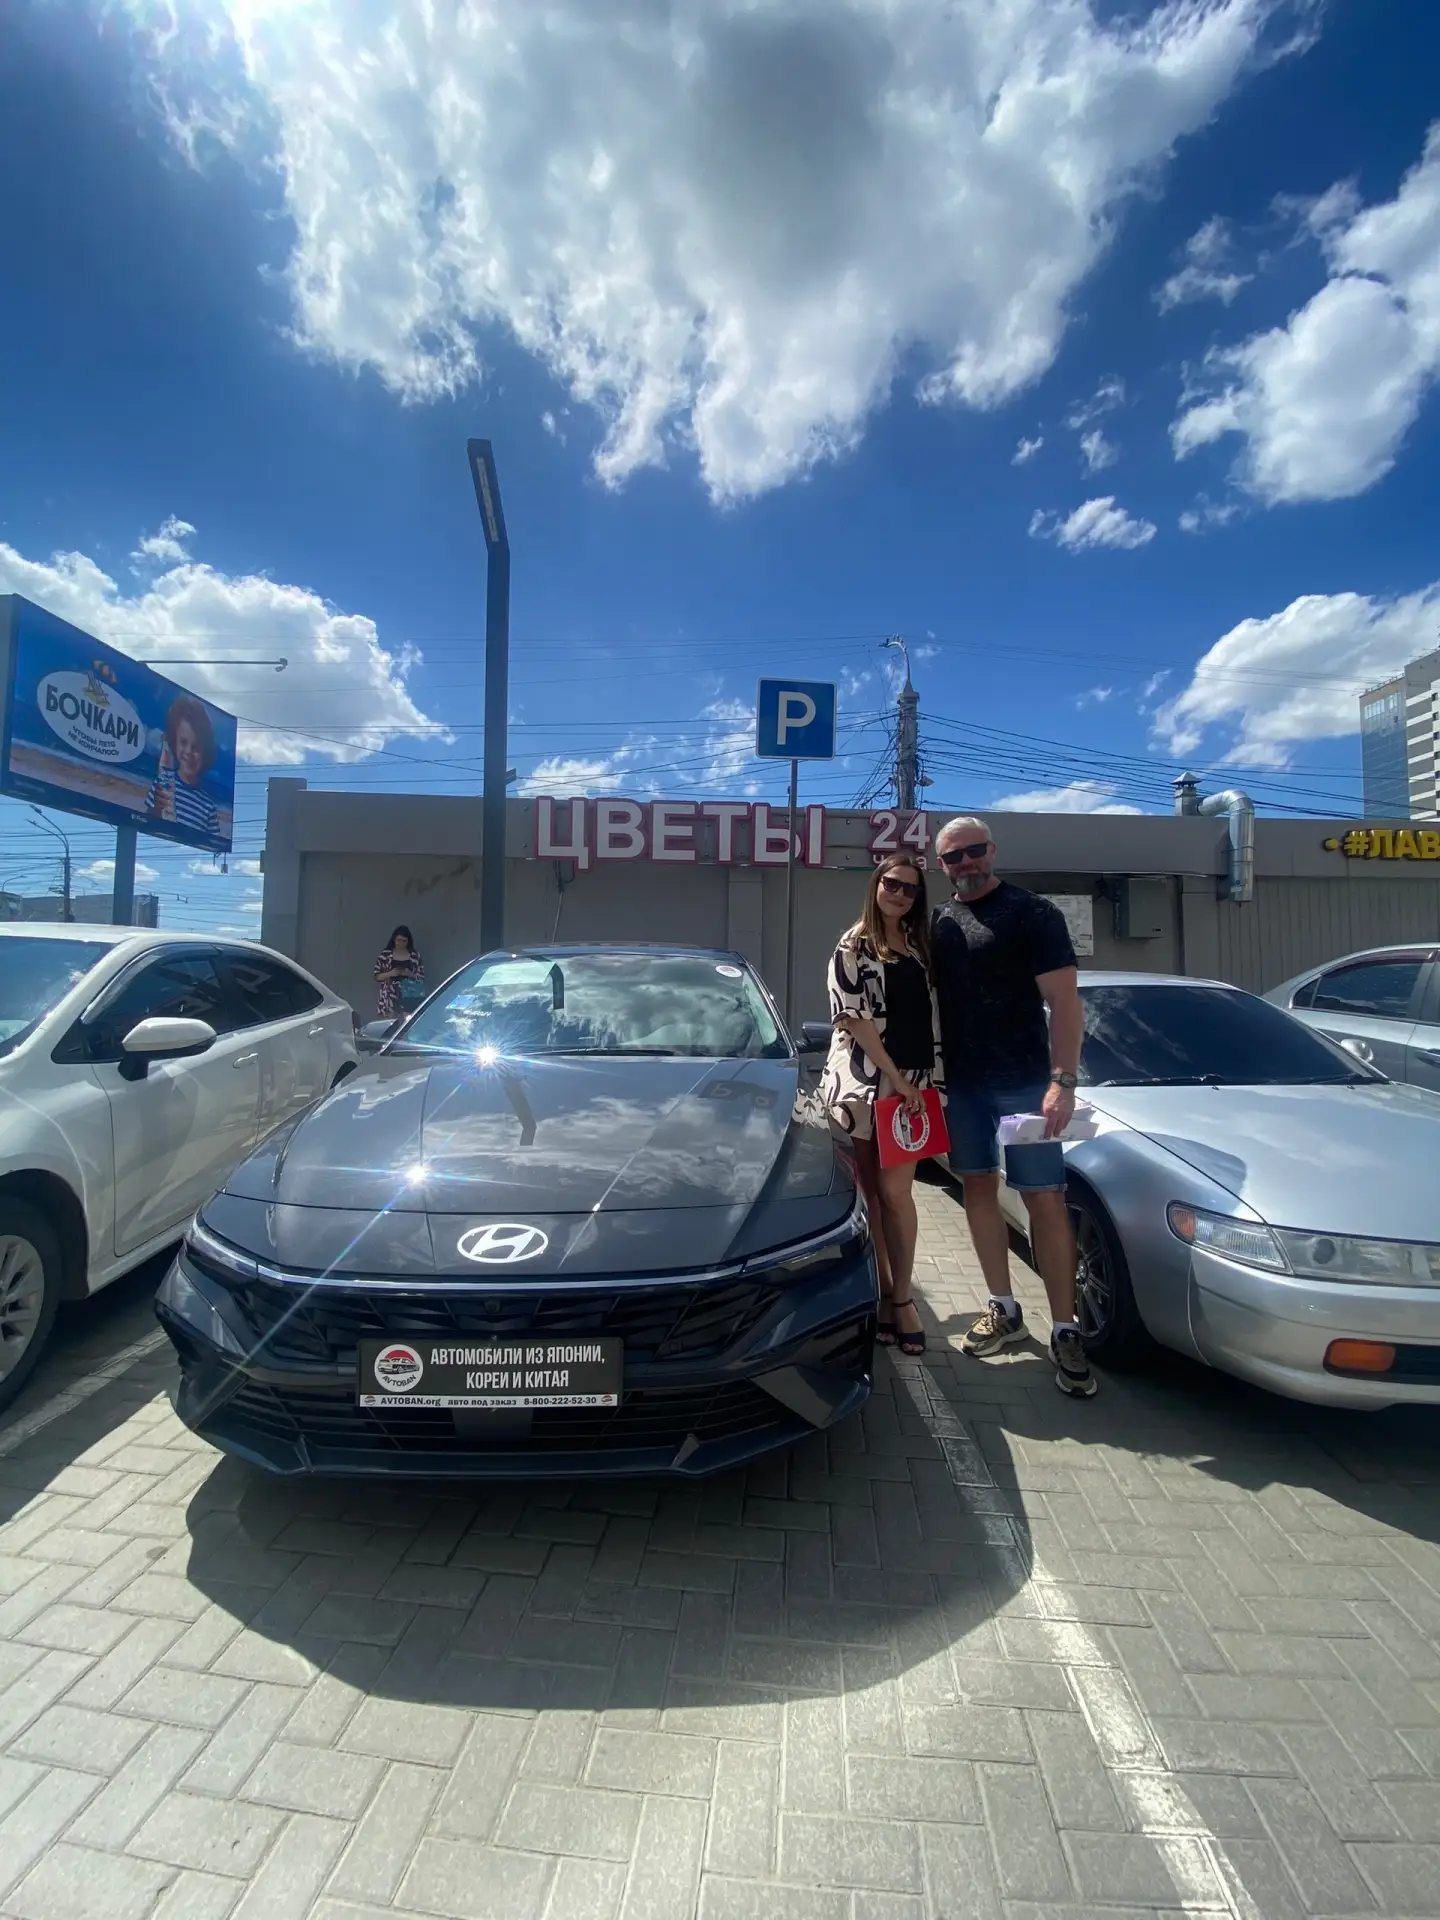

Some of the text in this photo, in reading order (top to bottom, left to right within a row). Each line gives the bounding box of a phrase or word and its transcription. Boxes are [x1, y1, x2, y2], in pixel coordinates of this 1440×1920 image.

[45, 684, 139, 747] БОЧКАРИ
[776, 691, 816, 745] P
[72, 725, 117, 748] ЧТОБЫ ЛЕТО
[536, 796, 932, 873] ЦВЕТЫ 24
[430, 1345, 605, 1365] АВТОМОБИЛИ ИЗ ЯПОНИИ,
[382, 1374, 416, 1387] AVTOBAN
[466, 1370, 569, 1389] КОРЕИ И КИТАЯ
[381, 1397, 441, 1407] AVTOBAN.org
[471, 1399, 488, 1407] под
[523, 1396, 597, 1406] 8-800-222-52-30
